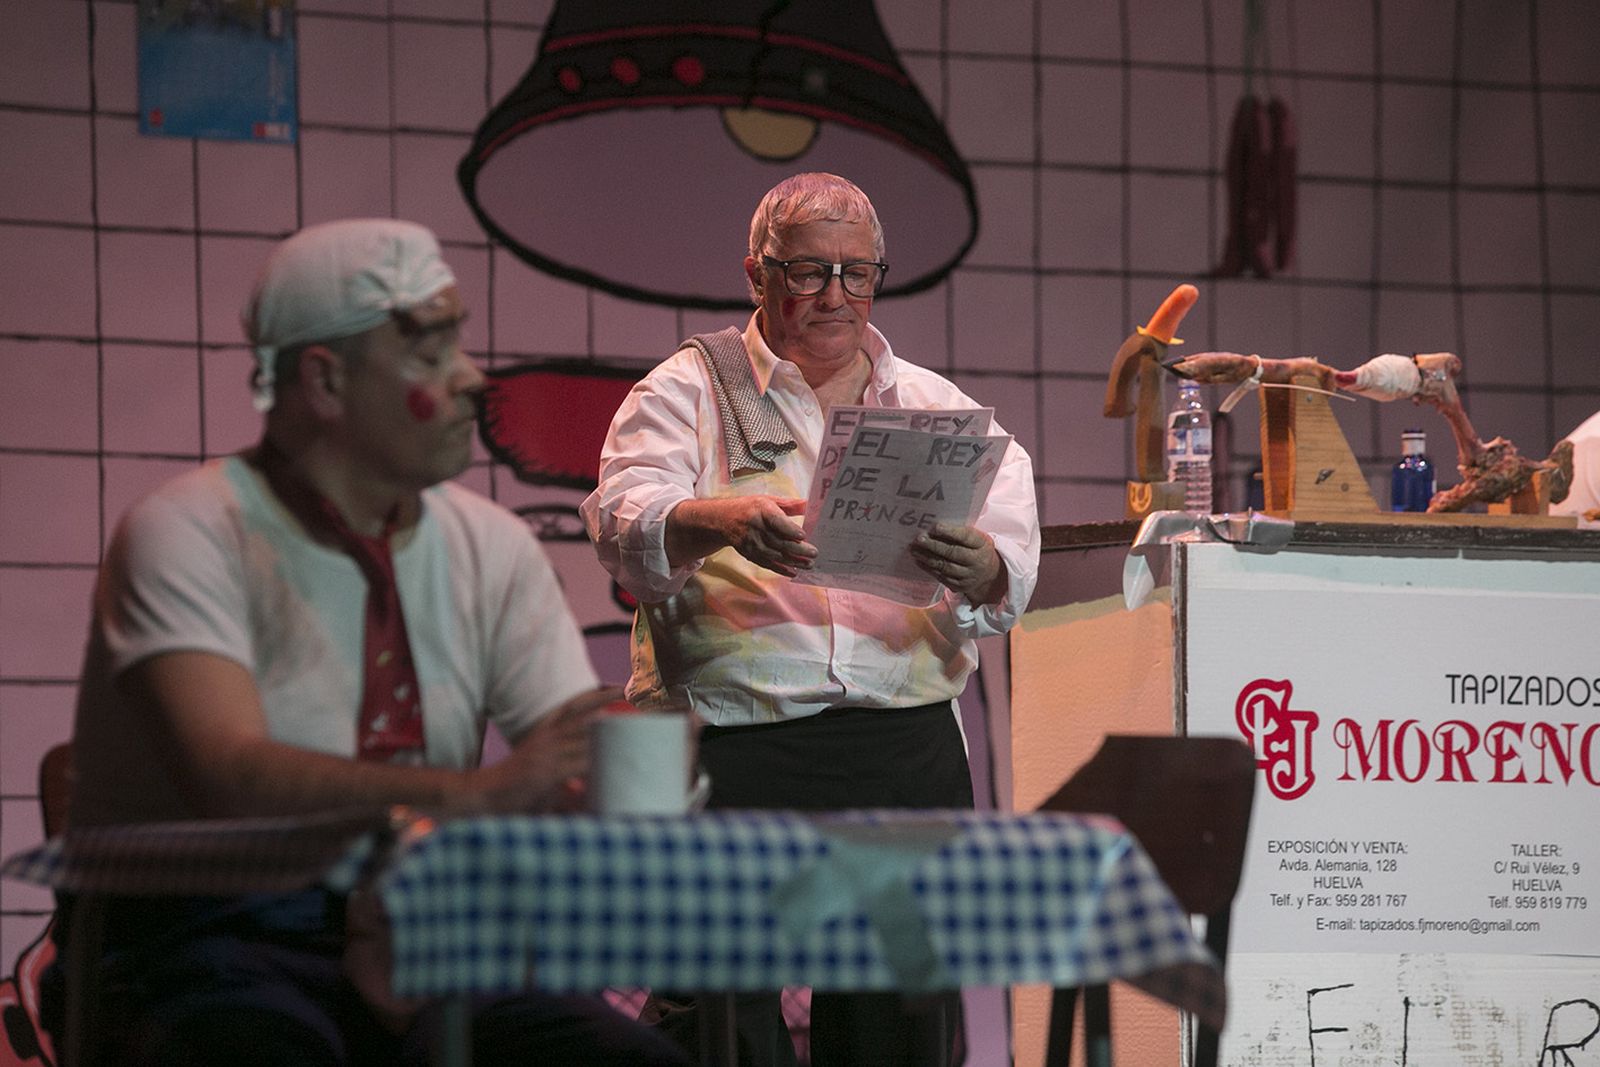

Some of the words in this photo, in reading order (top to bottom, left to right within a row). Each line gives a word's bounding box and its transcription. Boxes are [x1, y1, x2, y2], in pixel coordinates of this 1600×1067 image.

[851, 431, 900, 460] EL
[926, 436, 994, 468] REY
[835, 466, 881, 492] DE
[1267, 839, 1348, 854] EXPOSICIÓN
[1350, 841, 1360, 854] Y
[1362, 841, 1409, 854] VENTA:
[1511, 844, 1563, 857] TALLER:
[1279, 858, 1312, 872] Avda.
[1314, 858, 1372, 873] Alemania,
[1376, 859, 1398, 872] 128
[1494, 861, 1508, 874] C/
[1572, 862, 1580, 875] 9
[1313, 876, 1364, 889] HUELVA
[1512, 879, 1563, 892] HUELVA
[1270, 893, 1294, 907] Telf.
[1297, 896, 1305, 910] y
[1307, 894, 1332, 907] Fax:
[1335, 894, 1358, 907] 959
[1361, 894, 1382, 907] 281
[1386, 895, 1408, 907] 767
[1488, 896, 1512, 909] Telf.
[1515, 896, 1537, 909] 959
[1540, 896, 1562, 909] 819
[1565, 896, 1588, 909] 779
[1316, 917, 1356, 930] E-mail:
[1359, 917, 1541, 935] tapizados.fjmoreno@gmail.com
